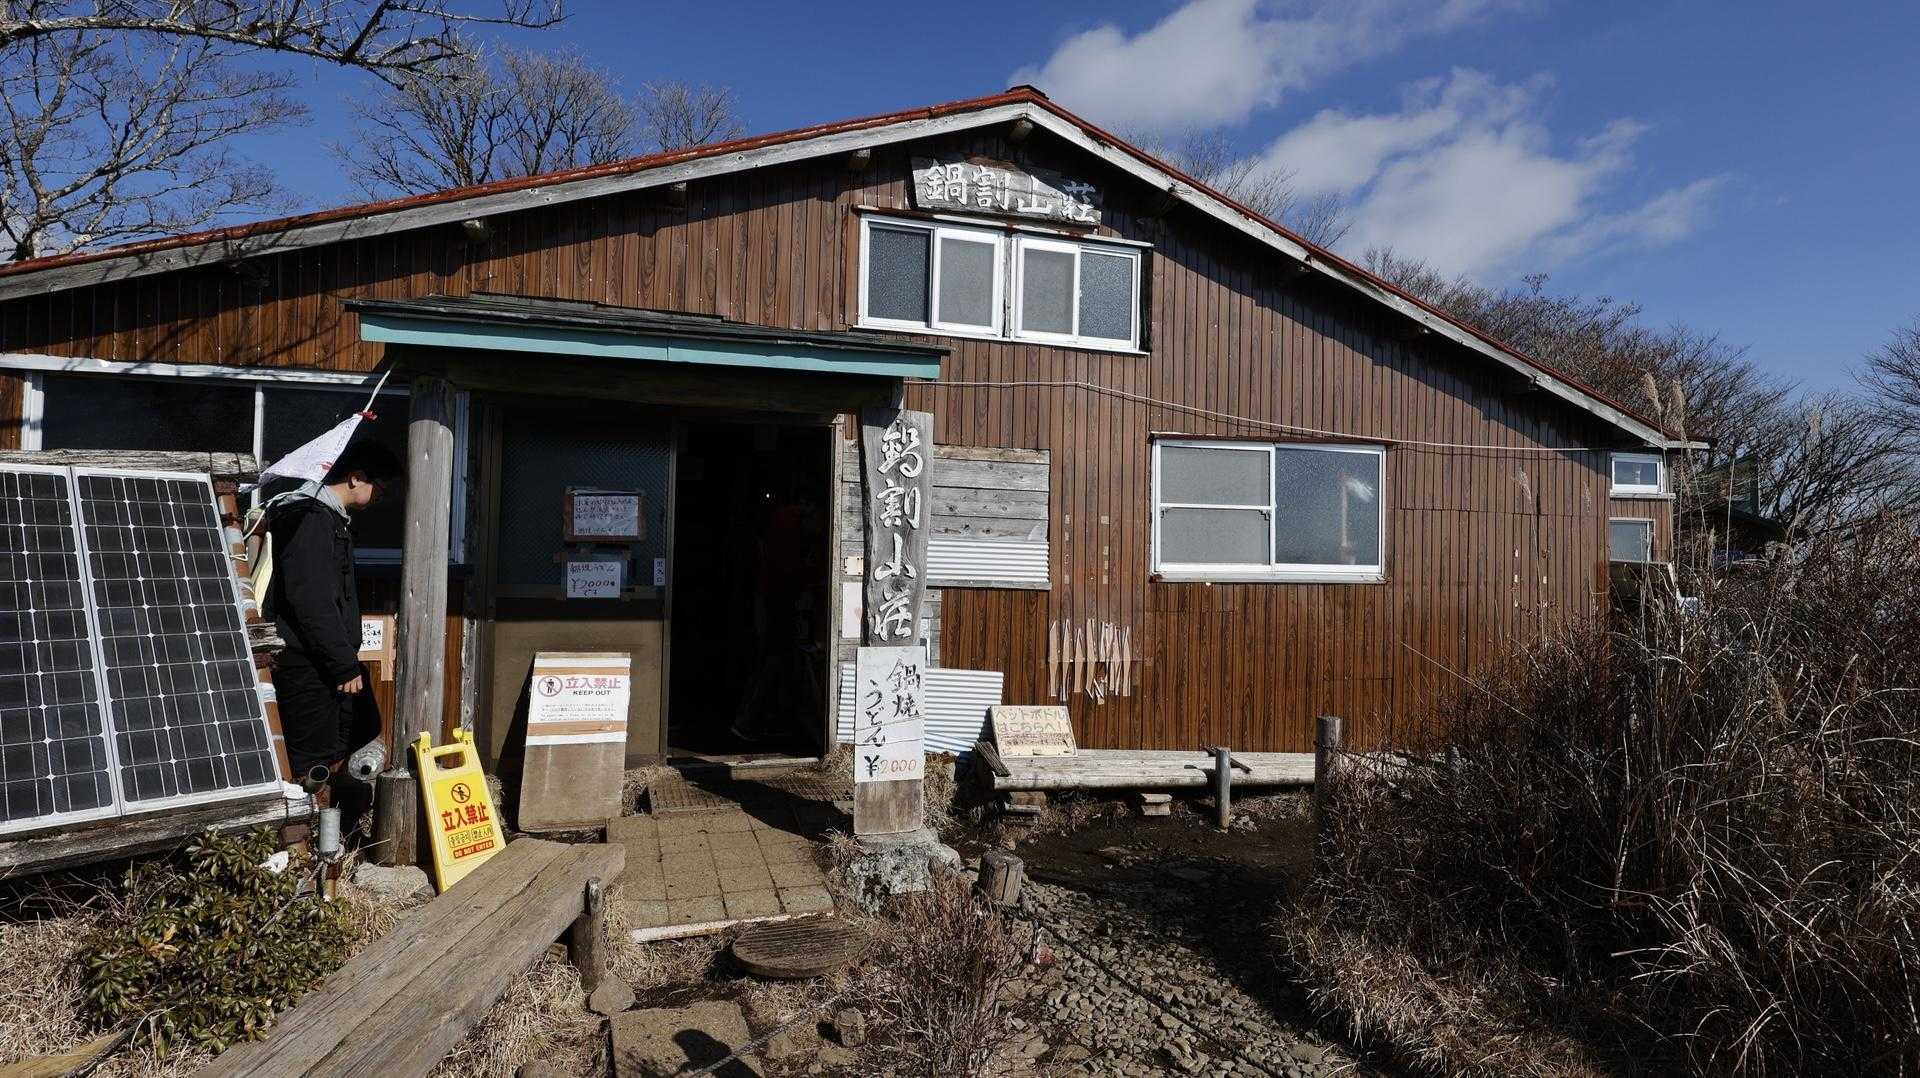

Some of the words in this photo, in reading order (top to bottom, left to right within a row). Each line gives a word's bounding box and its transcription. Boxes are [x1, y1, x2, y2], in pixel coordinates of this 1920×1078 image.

[923, 158, 1096, 224] 鍋割山荘
[875, 420, 924, 642] 鍋割山荘
[565, 677, 621, 689] 立入禁止
[887, 658, 921, 718] 鍋焼
[864, 679, 886, 748] うどん
[864, 755, 917, 778] ¥2000
[441, 802, 489, 831] 立入禁止
